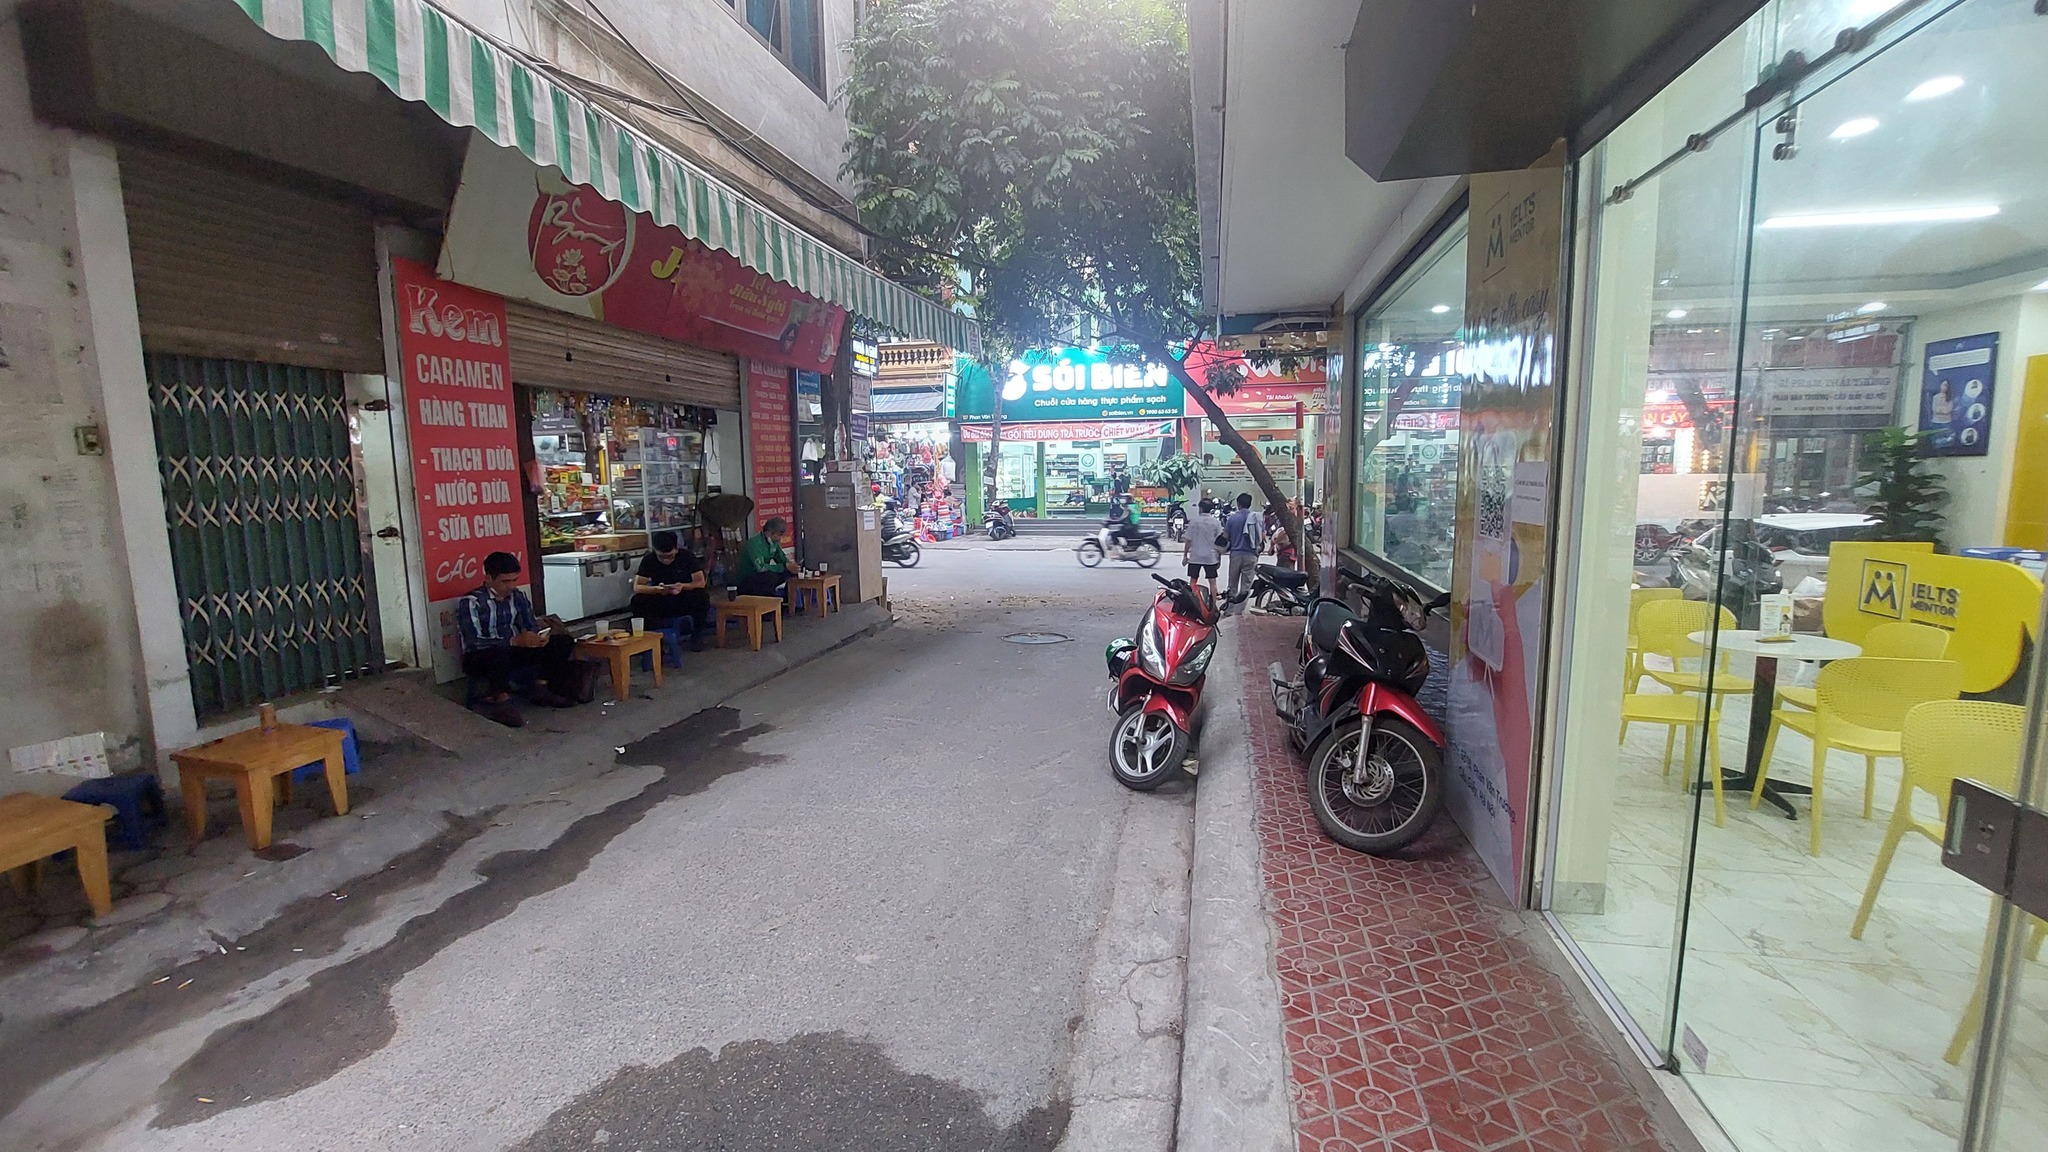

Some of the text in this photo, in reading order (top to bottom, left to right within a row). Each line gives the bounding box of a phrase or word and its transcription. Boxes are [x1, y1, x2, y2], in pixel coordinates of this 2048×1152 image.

[1510, 192, 1536, 230] IELTS
[405, 283, 503, 348] Kem
[416, 353, 504, 391] CARAMEN
[419, 394, 508, 429] HÀNG THAN
[1078, 396, 1098, 407] hàng
[1100, 397, 1118, 406] thực
[1146, 395, 1166, 404] sạch
[1038, 427, 1058, 438] DÙNG
[431, 447, 515, 477] THẠCH DỪA
[435, 478, 511, 507] NƯỚC DỪA
[438, 512, 512, 543] SỮA CHUA
[436, 553, 478, 583] CÁC
[1911, 583, 1959, 605] IELTS
[1911, 600, 1957, 618] MENTOR
